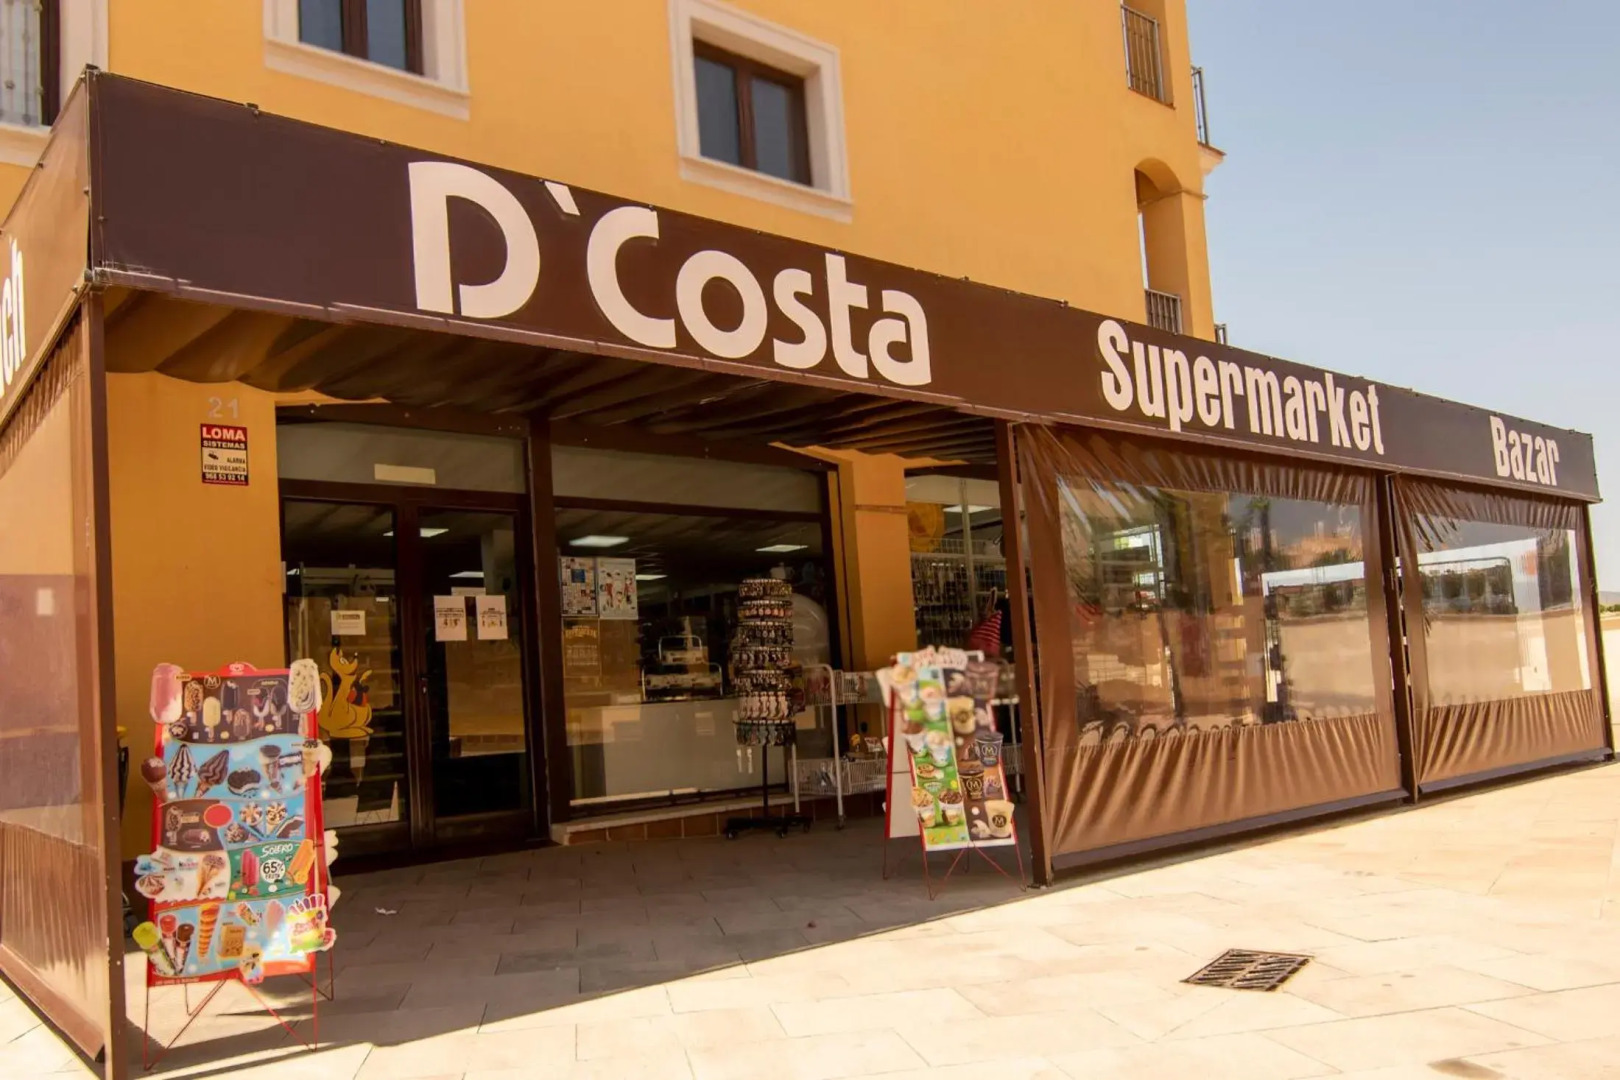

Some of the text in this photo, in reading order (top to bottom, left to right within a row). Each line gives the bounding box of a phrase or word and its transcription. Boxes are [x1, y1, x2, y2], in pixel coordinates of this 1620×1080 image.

[1097, 319, 1385, 456] Supermarket
[207, 397, 239, 419] 21
[202, 427, 245, 441] LOMA
[203, 440, 245, 449] SISTEMAS
[1490, 415, 1560, 486] Bazar
[262, 861, 284, 874] 65%
